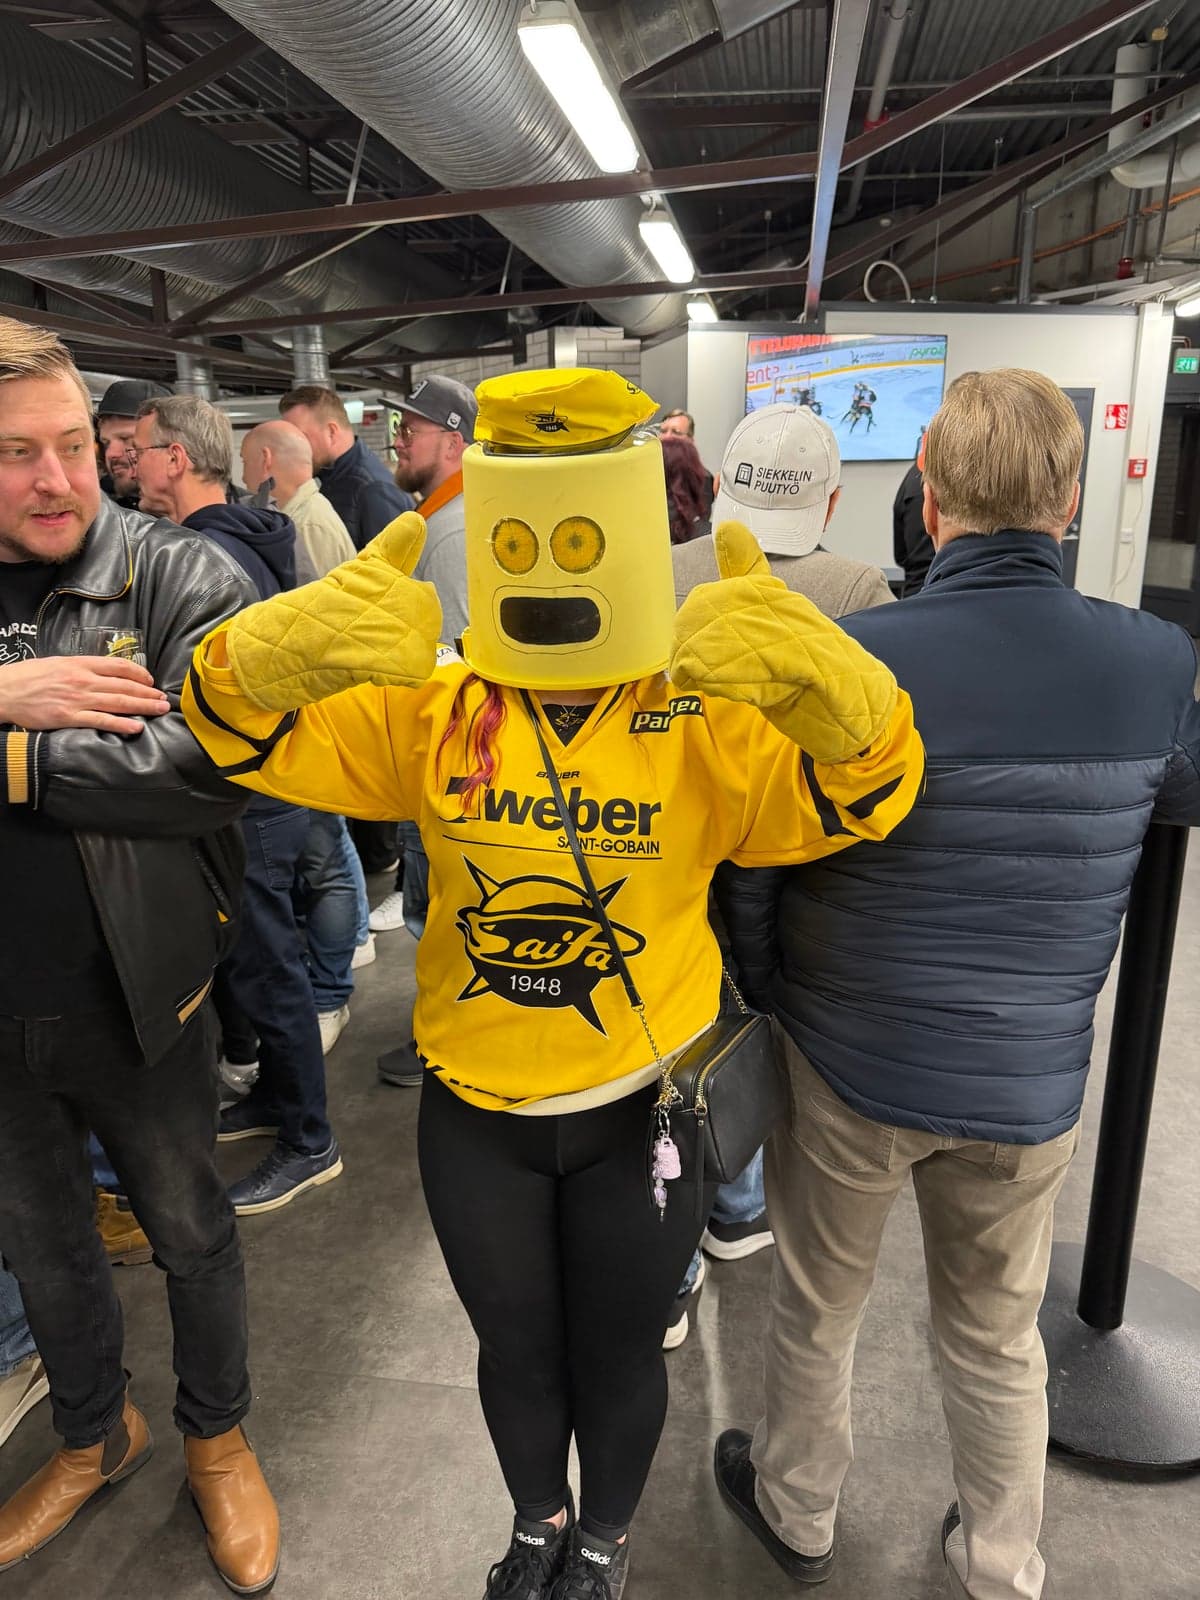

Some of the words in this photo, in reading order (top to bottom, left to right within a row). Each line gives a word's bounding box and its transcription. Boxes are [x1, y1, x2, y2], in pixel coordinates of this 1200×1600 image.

[756, 467, 813, 482] SIEKKELIN
[753, 480, 800, 495] PUUTYÖ
[536, 770, 580, 780] BUER
[484, 786, 663, 836] weber
[557, 836, 660, 855] SANT-GOBAIN
[509, 974, 562, 996] 1948
